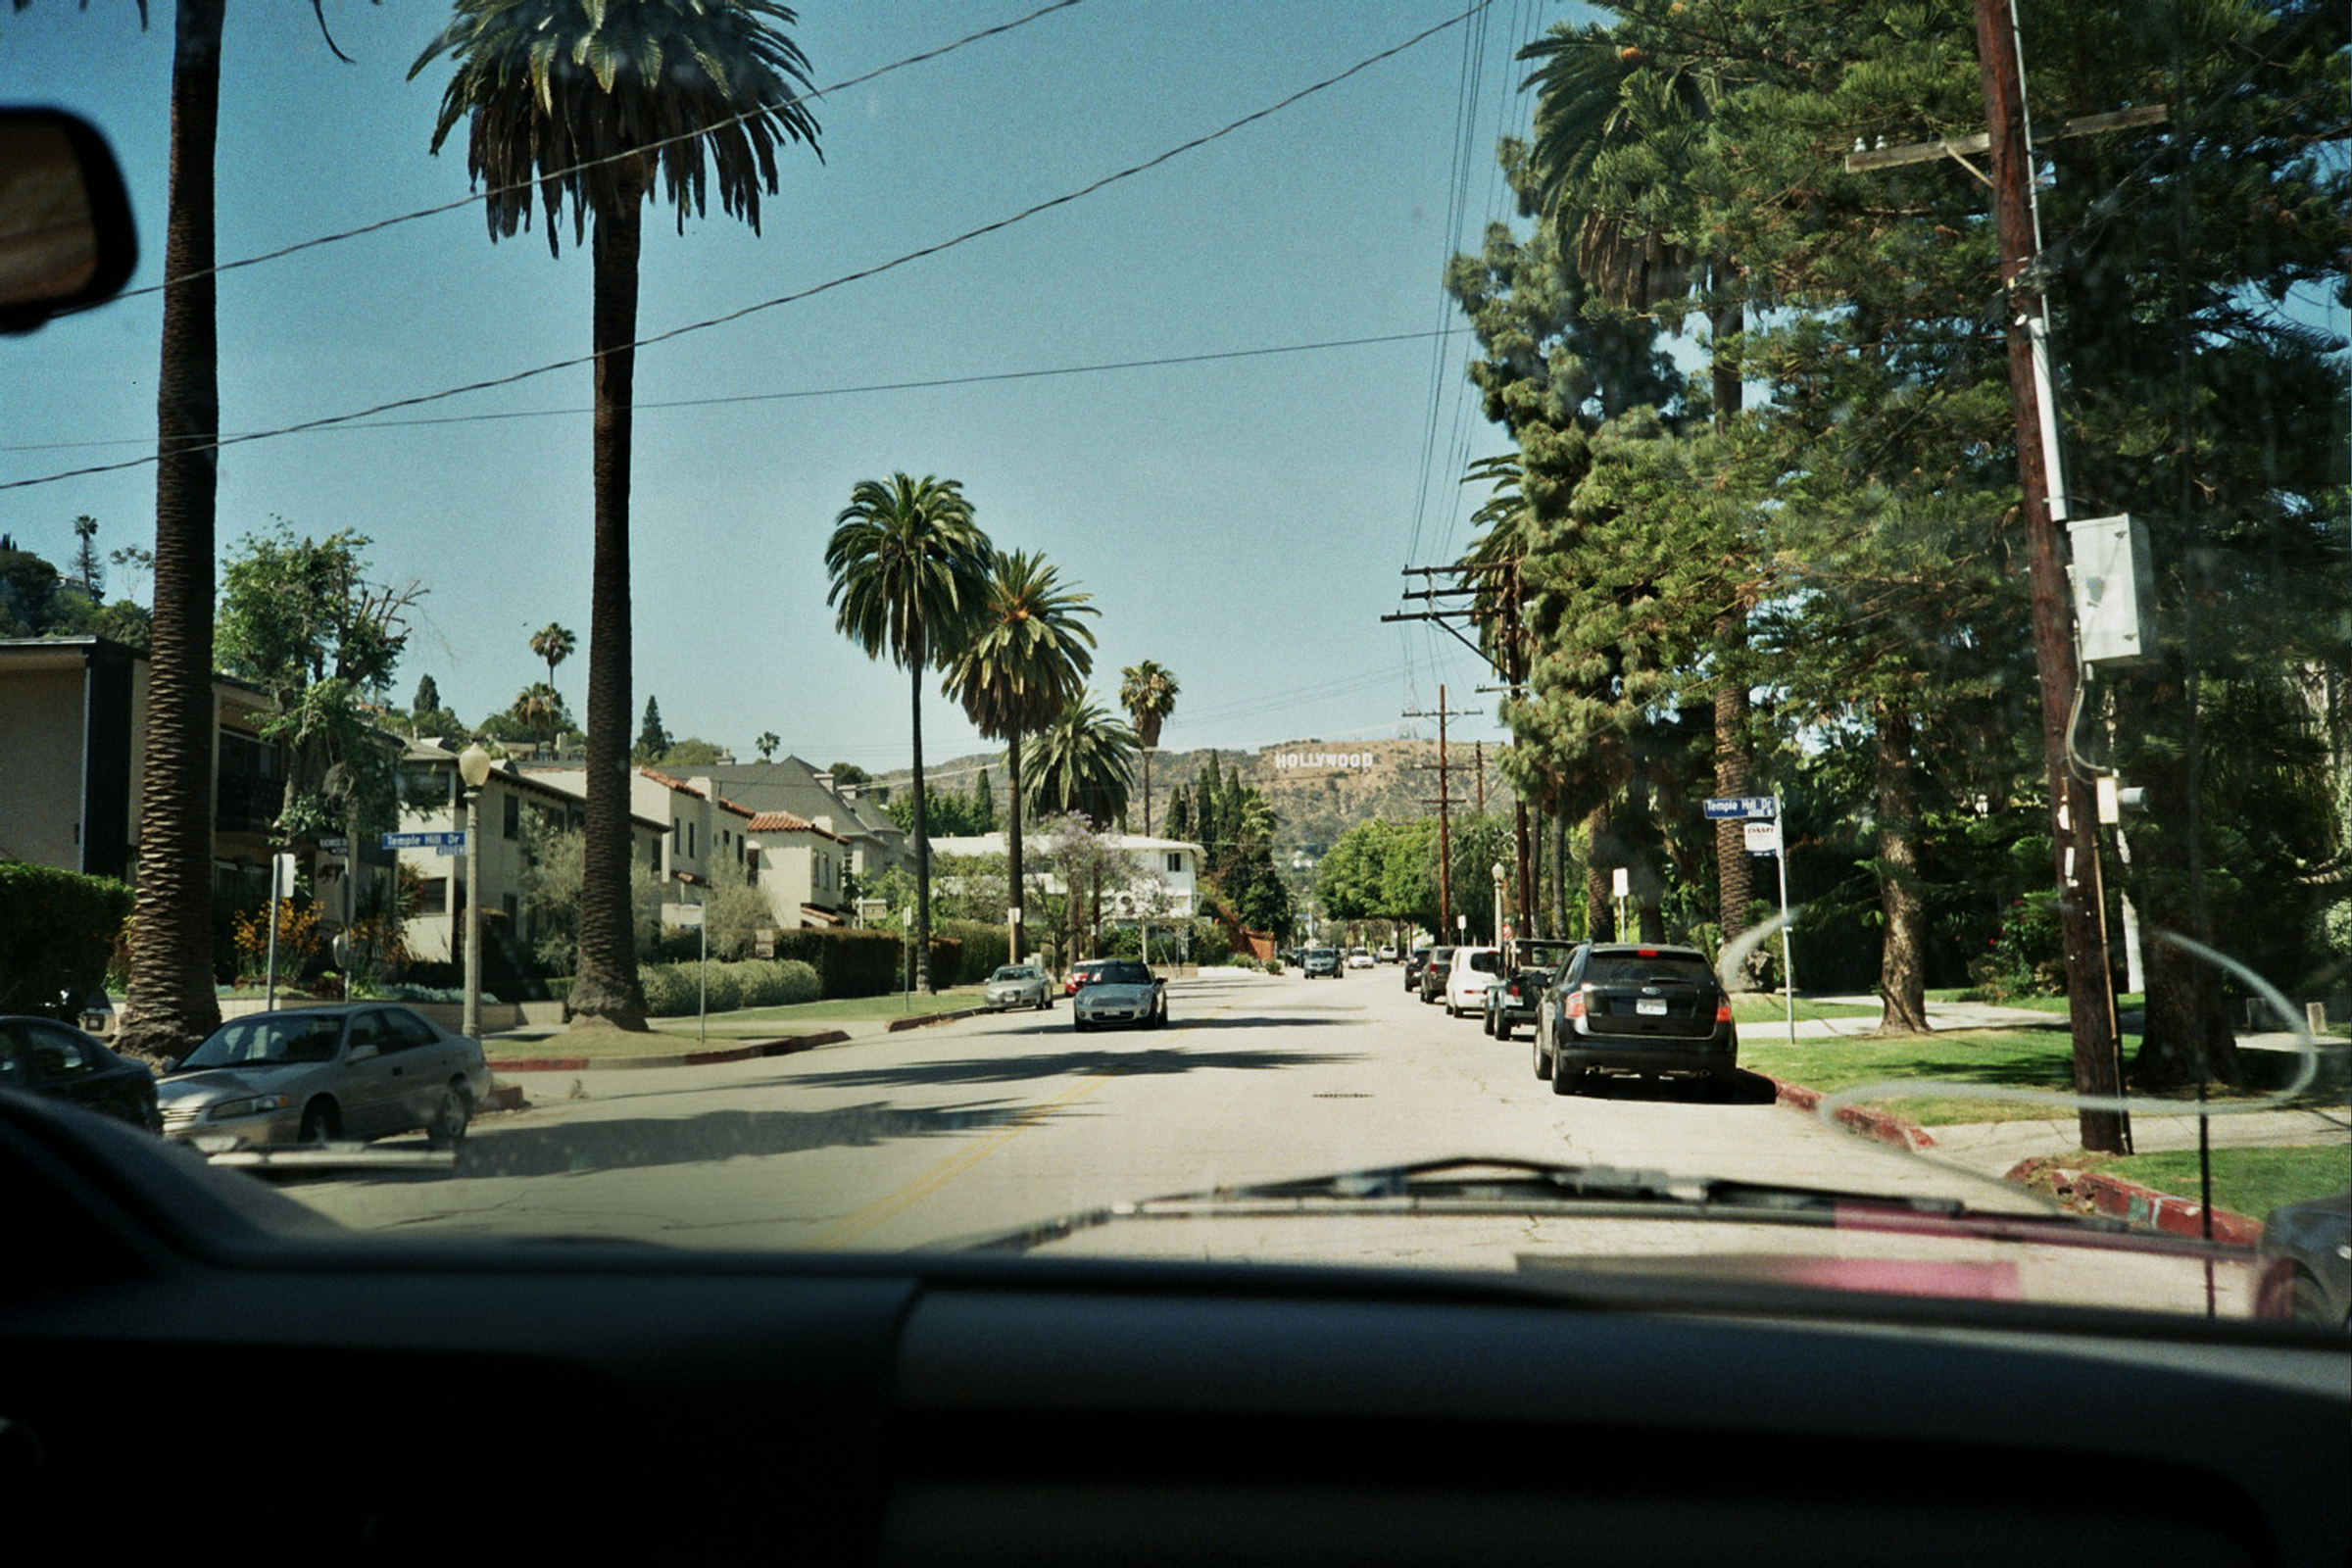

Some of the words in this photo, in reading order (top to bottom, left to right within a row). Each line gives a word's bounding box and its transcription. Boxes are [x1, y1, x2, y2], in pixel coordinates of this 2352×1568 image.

[1275, 752, 1373, 769] HOLLYWOOD
[1706, 800, 1738, 812] Temple
[1741, 799, 1756, 809] Hill
[1761, 799, 1773, 809] Dr
[387, 834, 421, 846] Temple
[425, 834, 441, 845] Hill
[447, 833, 461, 845] Dr
